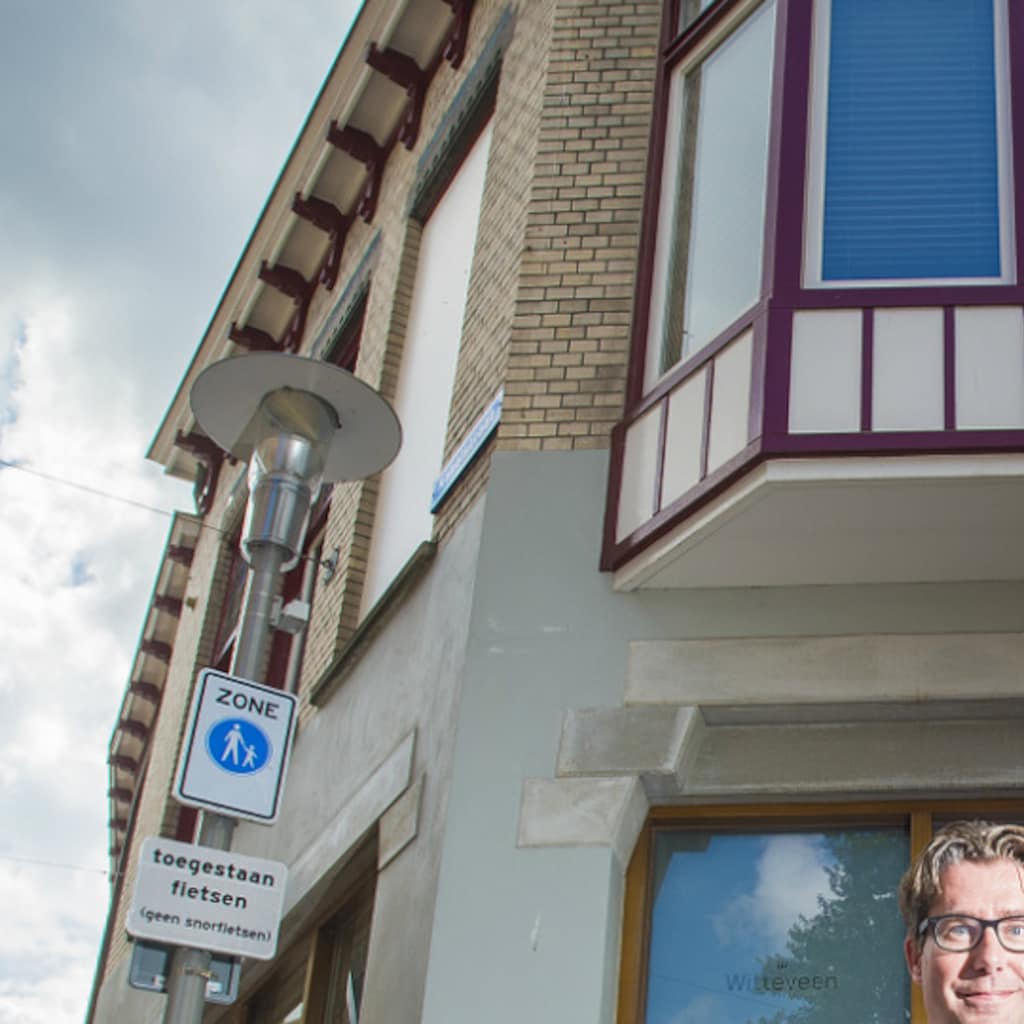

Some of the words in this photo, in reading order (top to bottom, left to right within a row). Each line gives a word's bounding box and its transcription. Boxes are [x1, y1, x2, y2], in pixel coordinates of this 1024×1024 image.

[215, 687, 280, 720] ZONE
[152, 848, 275, 887] toegestaan
[171, 879, 248, 909] fietsen
[139, 906, 181, 925] (geen
[184, 917, 272, 942] snorfietsen)
[725, 972, 839, 992] Witteveen
